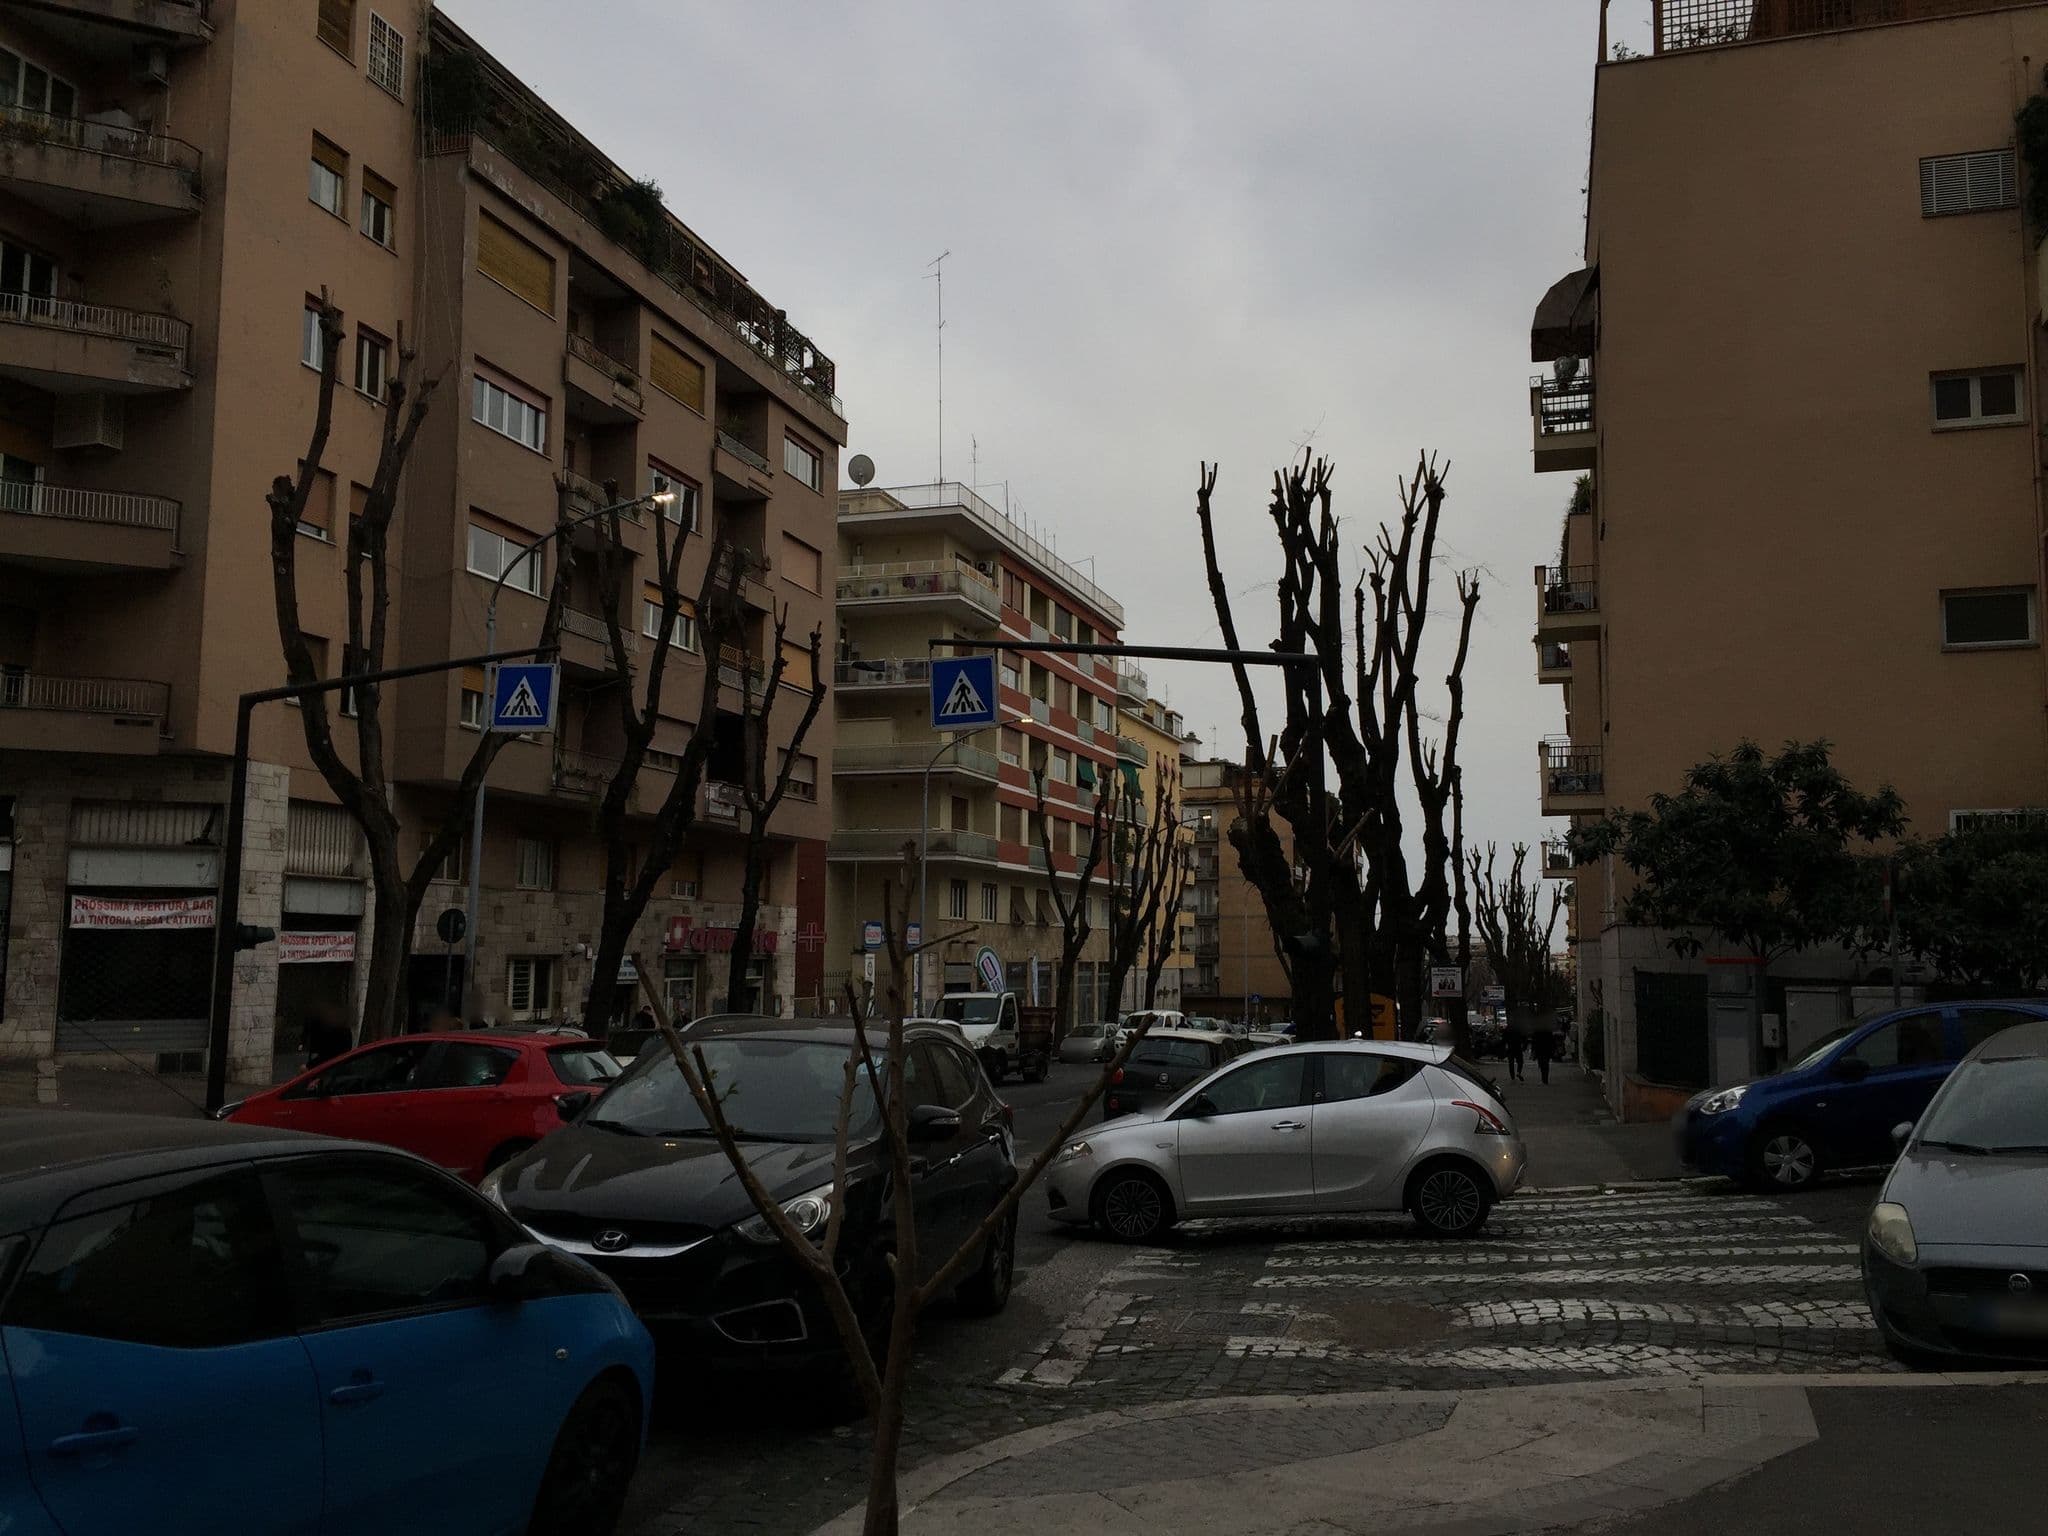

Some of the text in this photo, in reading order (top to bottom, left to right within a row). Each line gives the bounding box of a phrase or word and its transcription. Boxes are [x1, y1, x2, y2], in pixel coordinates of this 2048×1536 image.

[74, 898, 214, 912] PROSSIMA APERTURA BAR
[73, 914, 85, 924] LA
[88, 915, 131, 925] TINTORIA
[134, 915, 163, 925] CESSA
